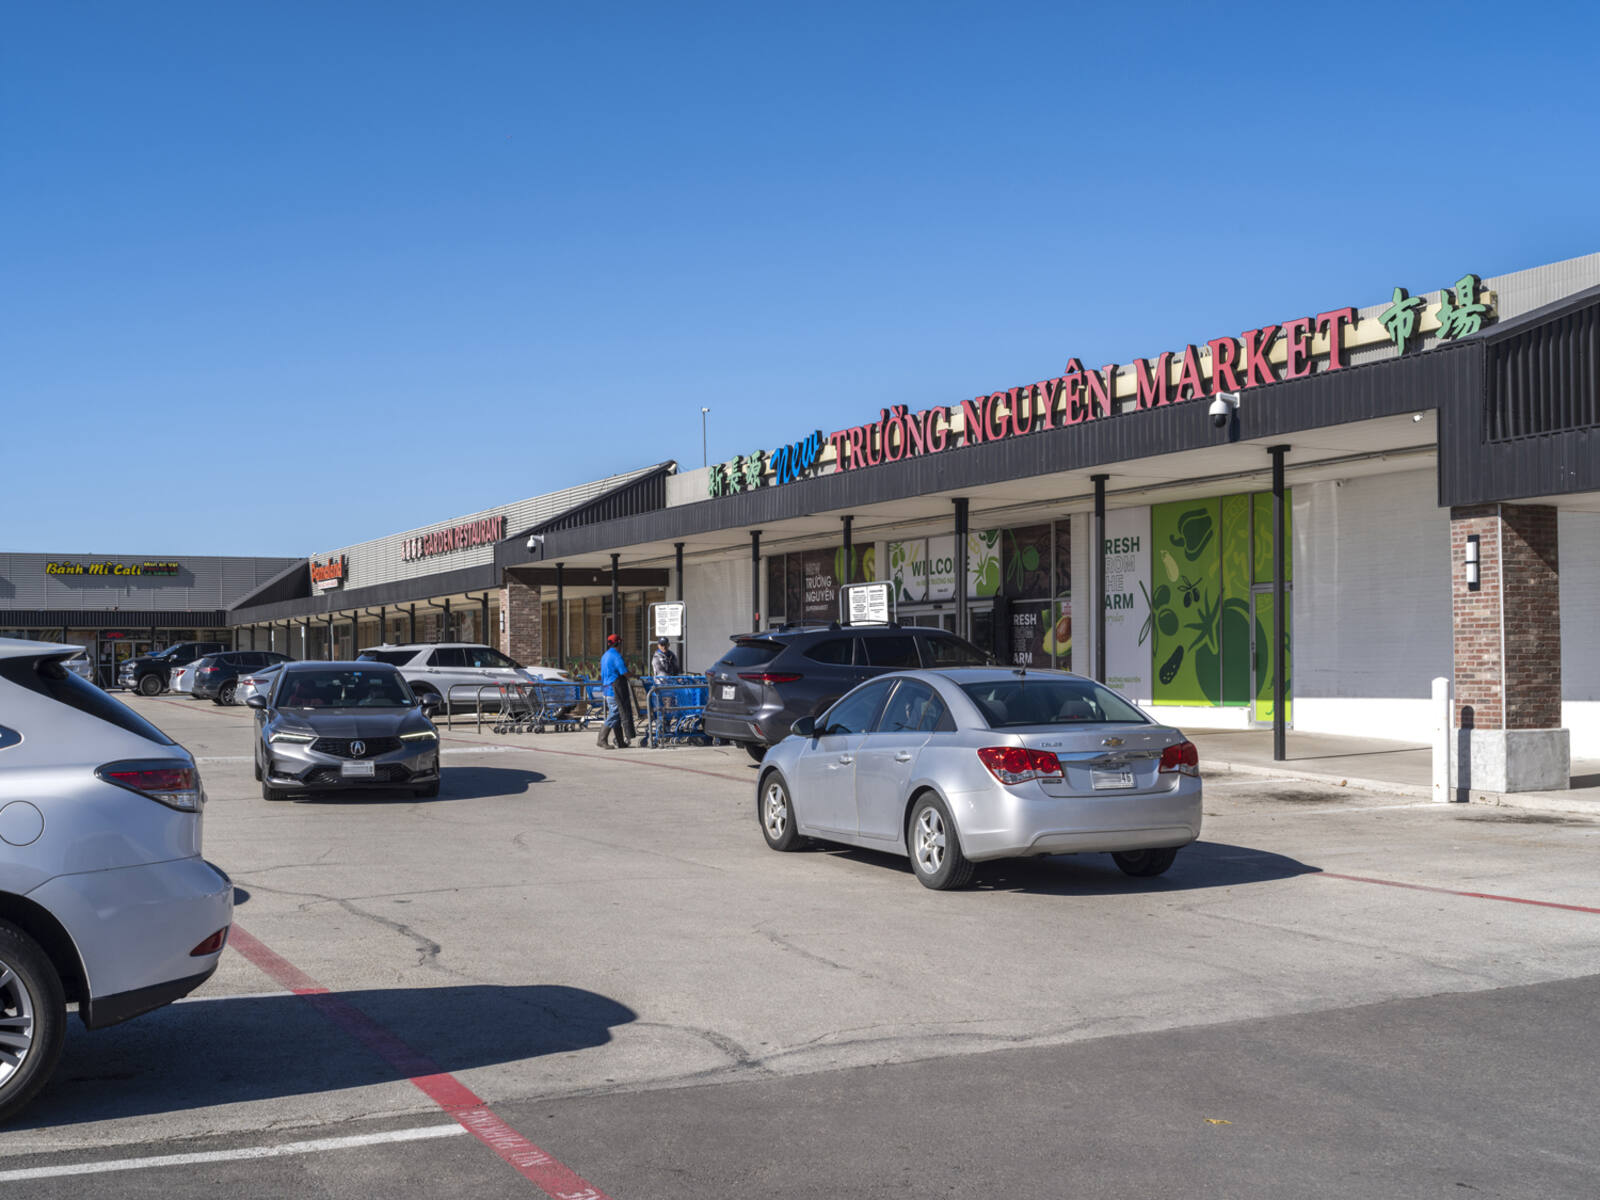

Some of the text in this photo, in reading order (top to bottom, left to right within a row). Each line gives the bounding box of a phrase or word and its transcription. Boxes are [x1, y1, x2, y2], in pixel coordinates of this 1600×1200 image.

[960, 358, 1114, 446] NGUYÊN
[1133, 307, 1353, 410] MARKET
[1378, 274, 1487, 357] 市場
[424, 528, 453, 555] GARDEN
[454, 515, 503, 549] RESTAURANT
[1104, 536, 1140, 555] RESH
[46, 561, 83, 574] Bánh
[113, 564, 141, 575] Cali
[911, 557, 970, 577] WLCO
[1105, 555, 1136, 573] ROM
[1105, 574, 1124, 592] HE
[1104, 593, 1134, 610] ARM
[1013, 613, 1037, 625] RESH
[1013, 652, 1033, 664] ARM
